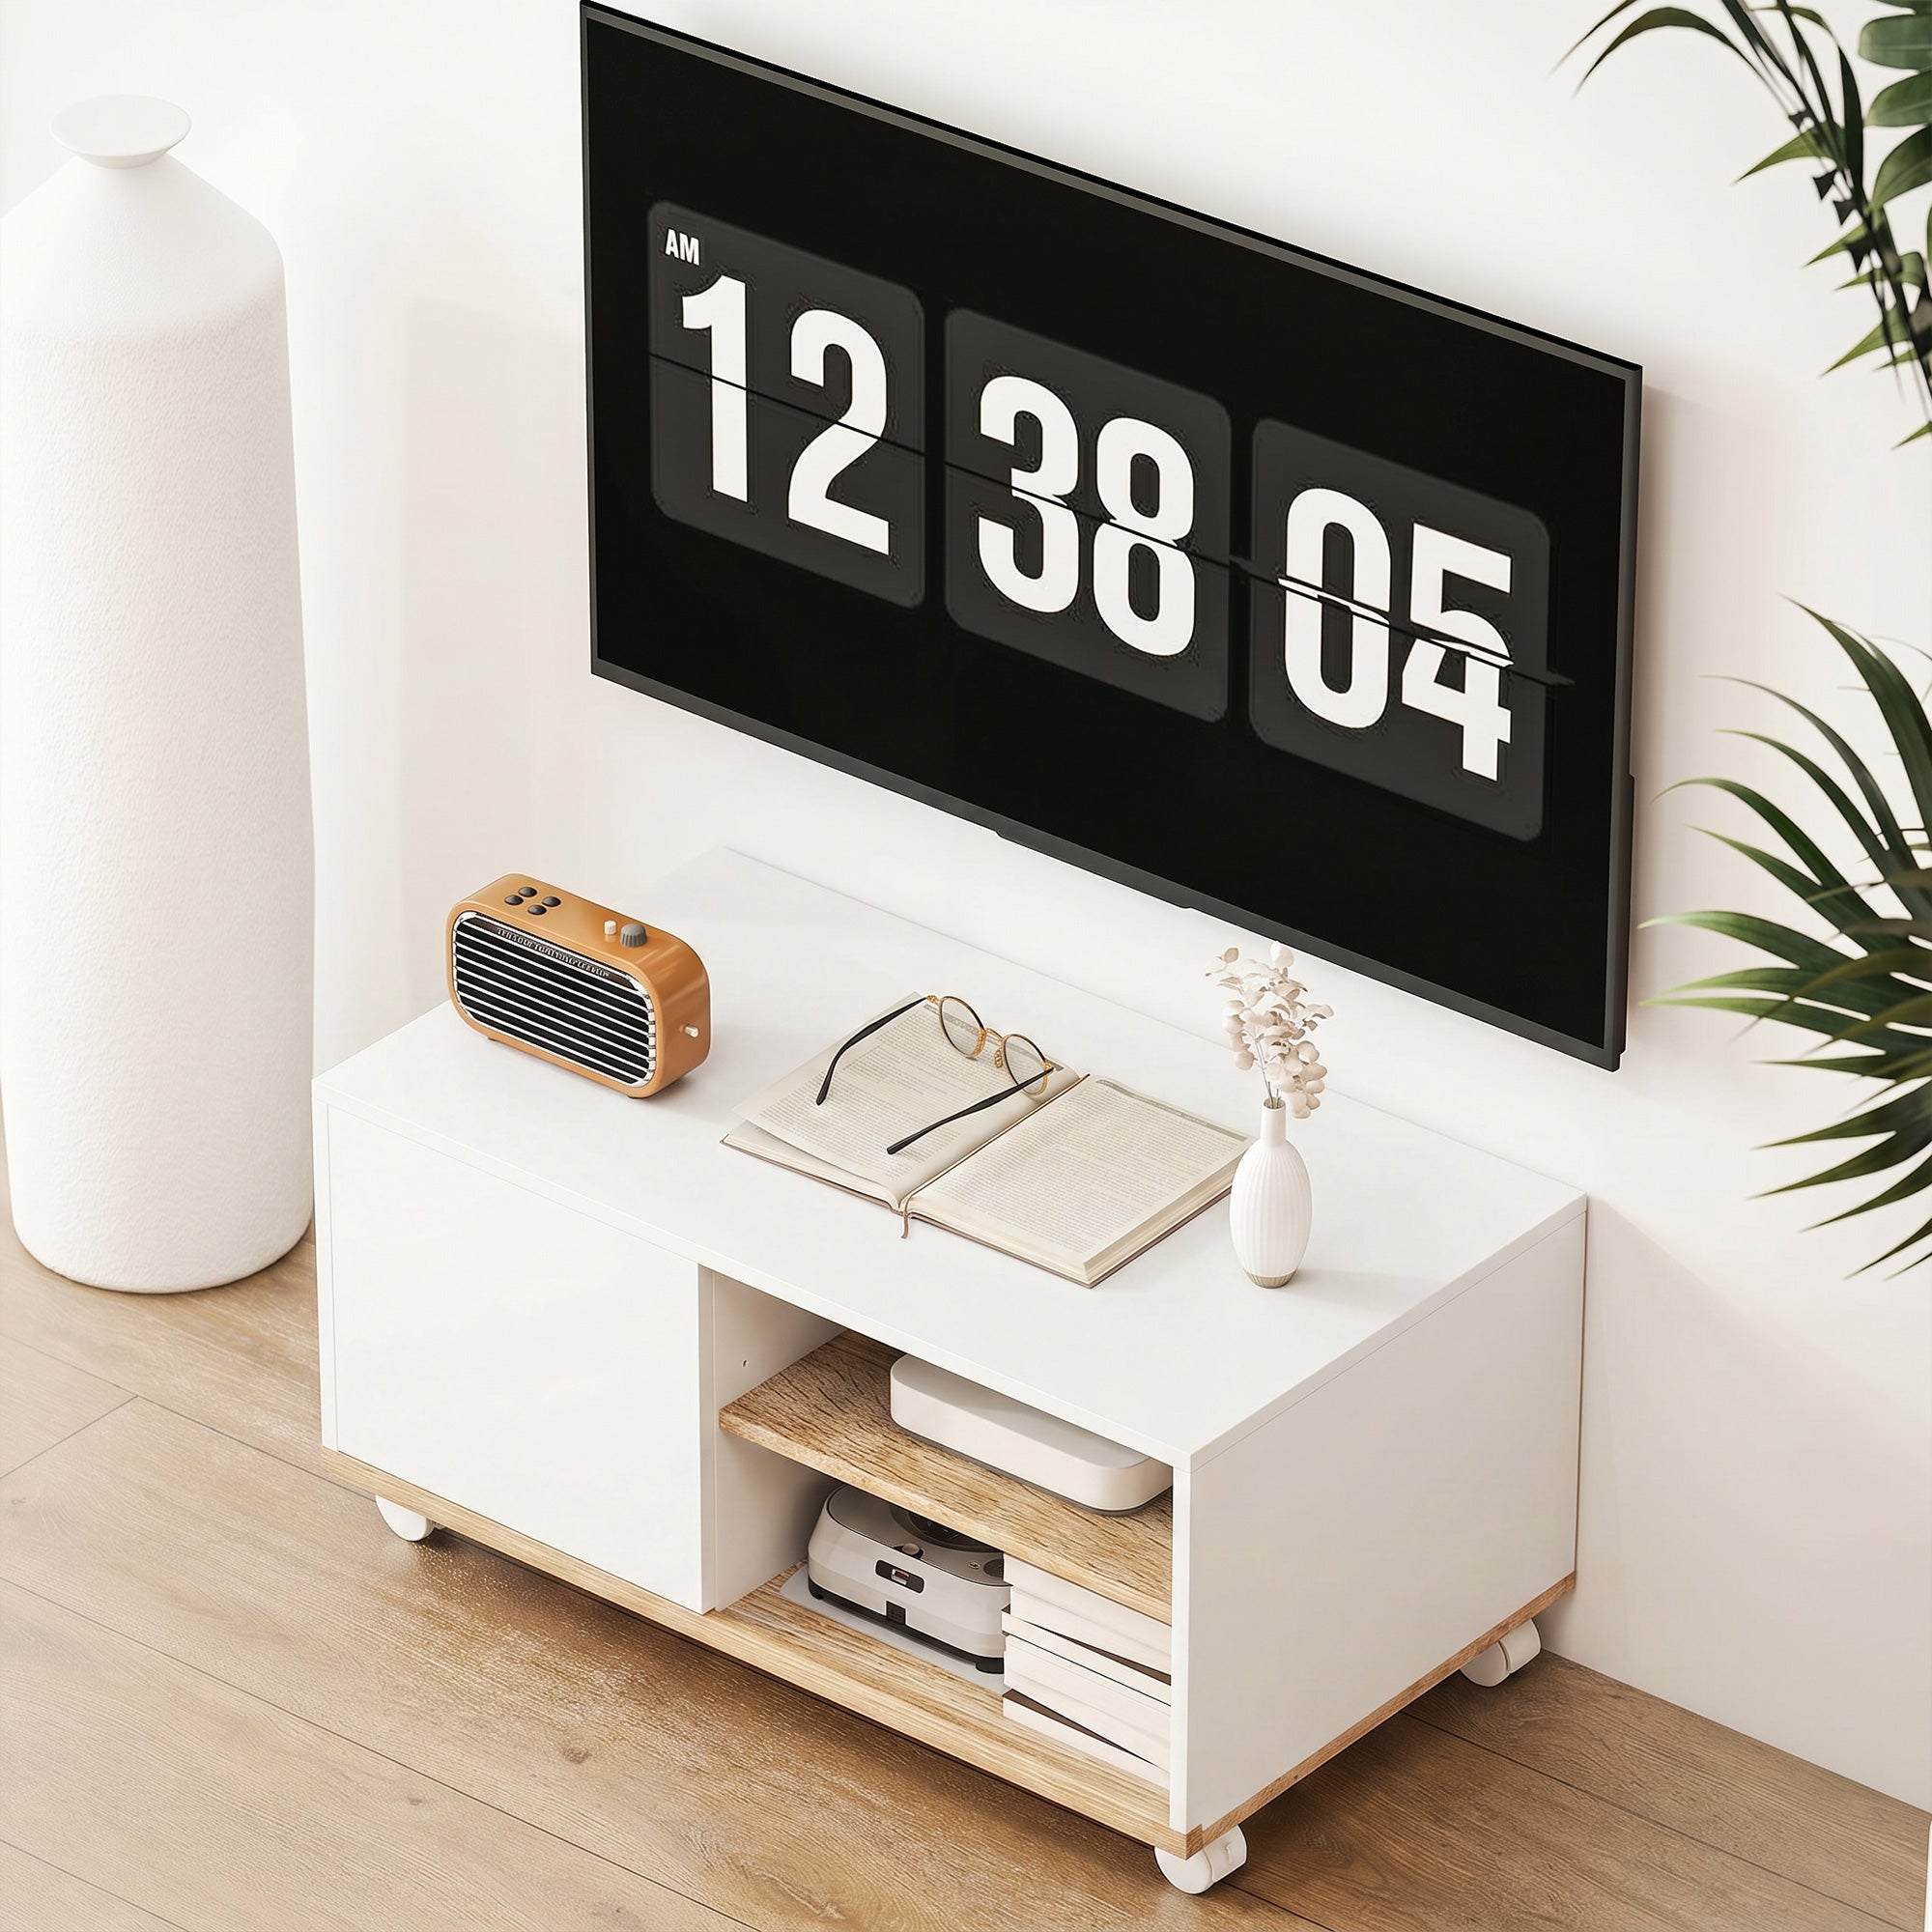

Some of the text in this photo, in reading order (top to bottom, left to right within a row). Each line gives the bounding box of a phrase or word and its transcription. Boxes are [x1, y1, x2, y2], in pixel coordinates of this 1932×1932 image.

[665, 228, 700, 266] AM
[682, 274, 890, 555] 12
[979, 376, 1195, 656] 38
